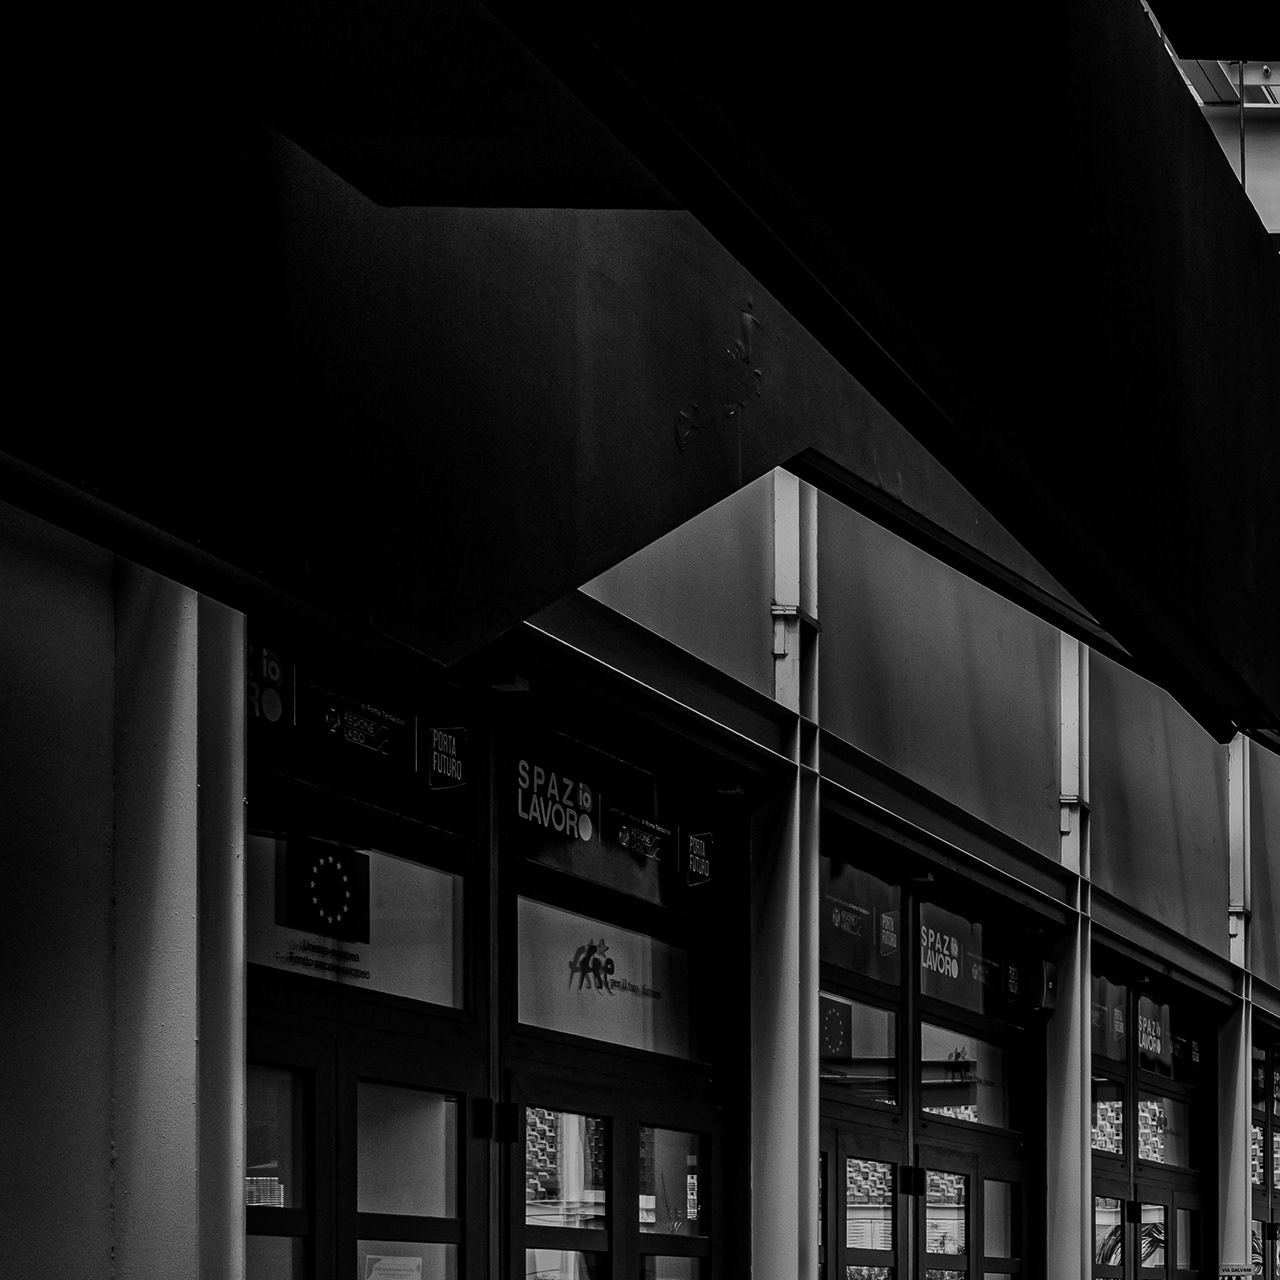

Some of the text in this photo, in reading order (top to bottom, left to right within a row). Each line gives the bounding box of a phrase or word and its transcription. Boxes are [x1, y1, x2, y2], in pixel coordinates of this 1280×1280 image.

[433, 728, 457, 758] PORTA
[433, 750, 462, 780] FUTURO
[518, 787, 593, 841] LAVORO
[921, 945, 959, 979] LAVORO
